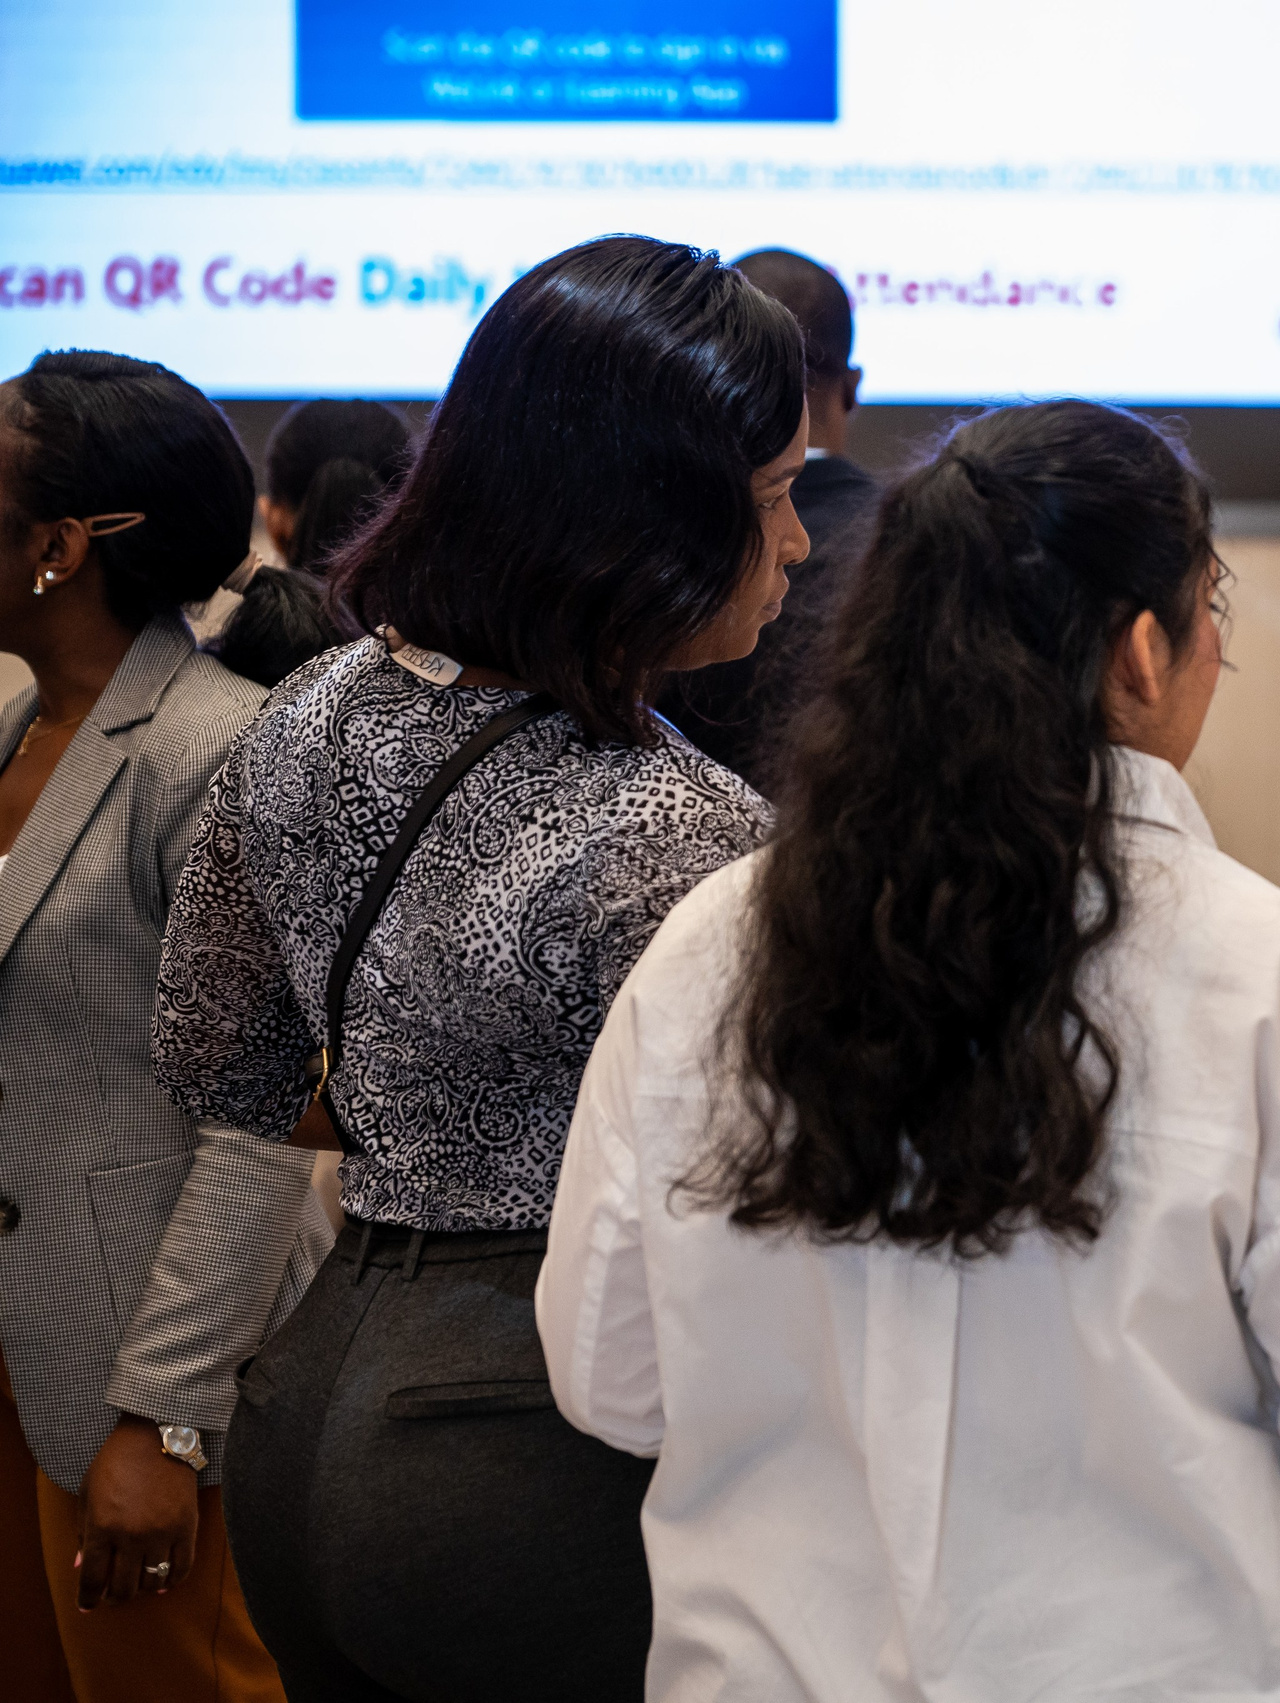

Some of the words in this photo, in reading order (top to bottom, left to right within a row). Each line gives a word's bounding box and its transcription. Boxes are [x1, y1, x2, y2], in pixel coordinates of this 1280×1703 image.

[103, 255, 183, 313] QR
[202, 255, 337, 306] Code
[361, 255, 487, 317] Daily
[826, 262, 1118, 307] ttendance
